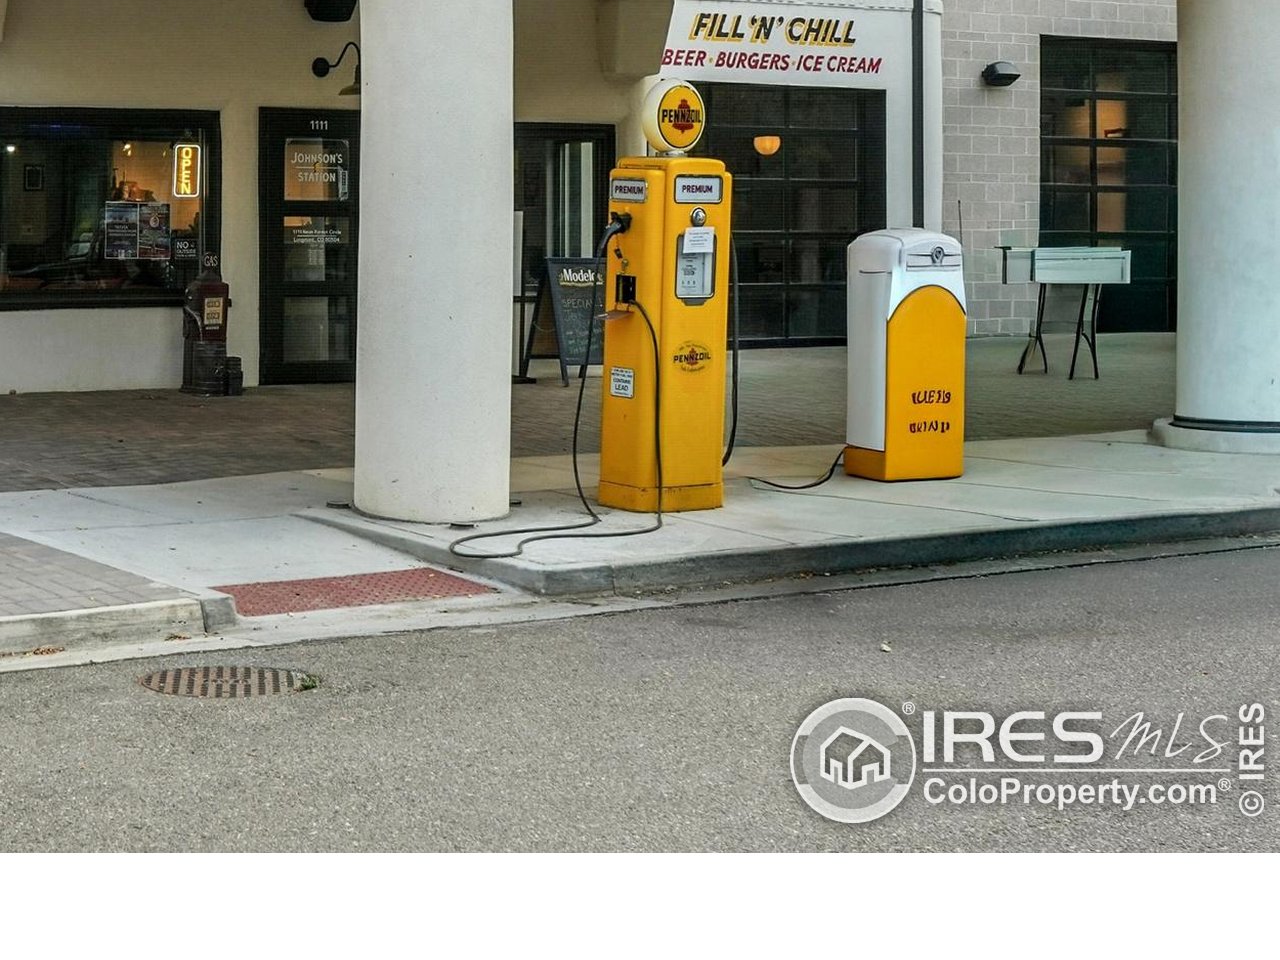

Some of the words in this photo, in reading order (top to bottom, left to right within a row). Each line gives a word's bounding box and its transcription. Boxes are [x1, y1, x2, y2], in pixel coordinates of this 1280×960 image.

[688, 12, 744, 42] FILL
[785, 17, 856, 46] CHILL
[661, 48, 707, 67] BEER
[715, 51, 791, 71] BURGERS
[796, 54, 824, 72] ICE
[826, 55, 882, 73] CREAM
[661, 109, 702, 123] PENNZOIL
[310, 120, 328, 130] 1111
[290, 152, 343, 164] JOHNSON'S
[181, 147, 192, 194] OPEN
[297, 171, 336, 182] STATION
[615, 185, 644, 195] PREMIUM
[681, 184, 713, 193] PREMIUM
[176, 241, 189, 249] NO
[203, 255, 219, 267] GAS
[673, 351, 712, 364] PENNZOIL
